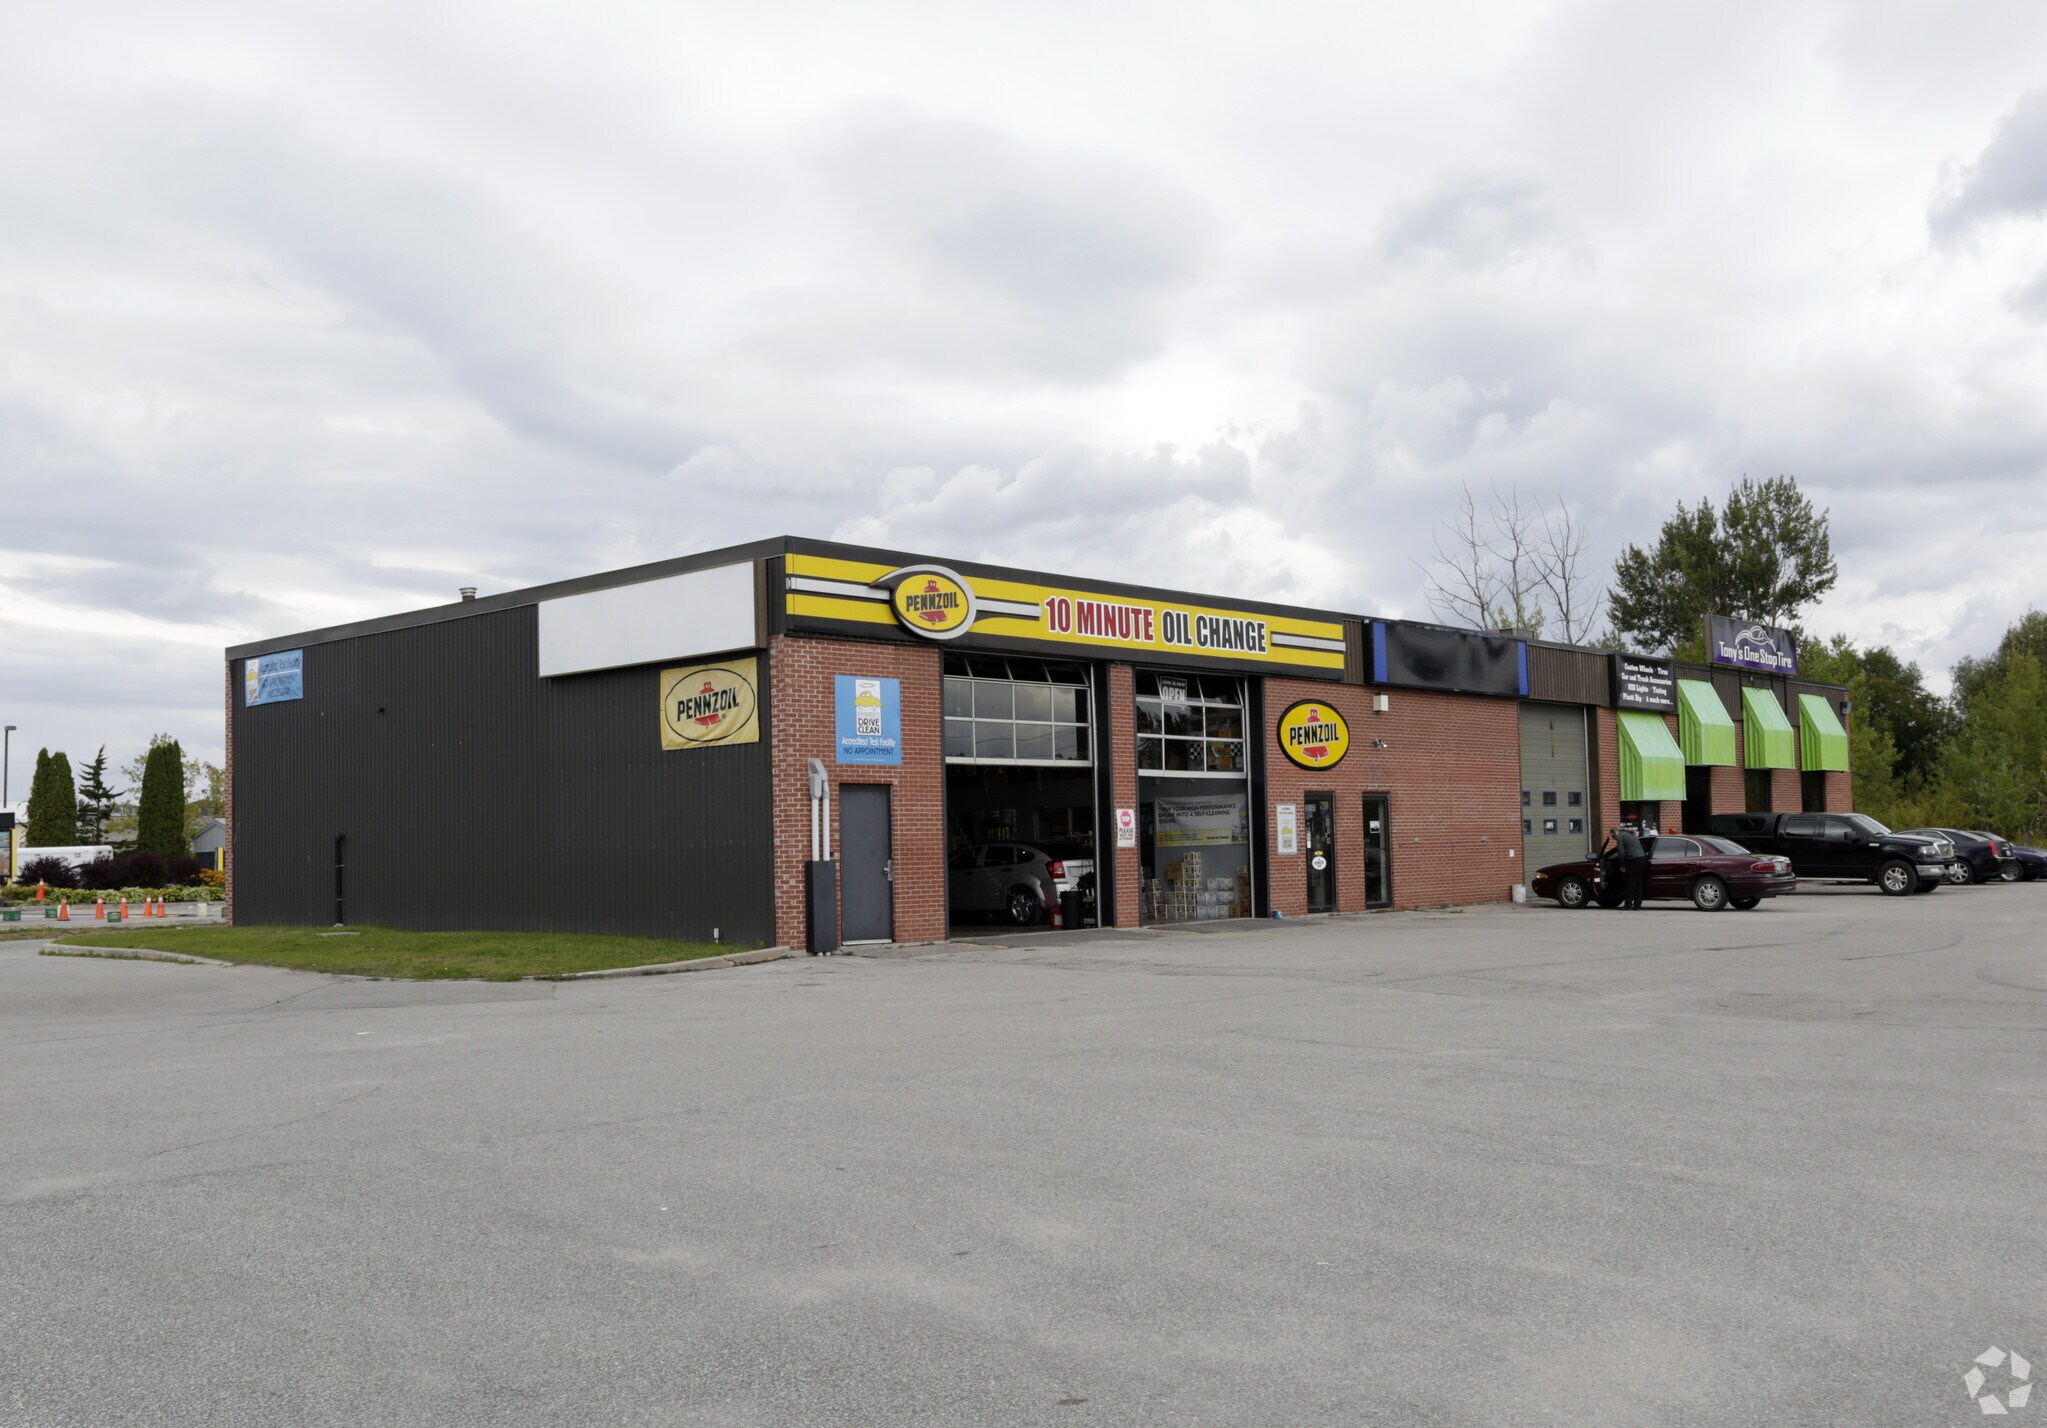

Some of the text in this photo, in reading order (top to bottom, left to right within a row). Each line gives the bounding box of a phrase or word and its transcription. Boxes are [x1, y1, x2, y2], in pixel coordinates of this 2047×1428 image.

[906, 591, 960, 612] PENNZOIL
[1045, 596, 1266, 653] 10 MINUTE OIL CHANGE
[1719, 641, 1792, 668] Tony's One Stop Tire
[1163, 687, 1185, 701] OPEN
[677, 687, 739, 722] PENNZOIL
[858, 718, 880, 726] DRIVE
[858, 726, 880, 734] CLEAN
[841, 737, 869, 746] Accredited
[869, 737, 879, 746] Test
[1289, 722, 1339, 746] PENNZOIL
[844, 747, 894, 756] NO APPOINTMENT
